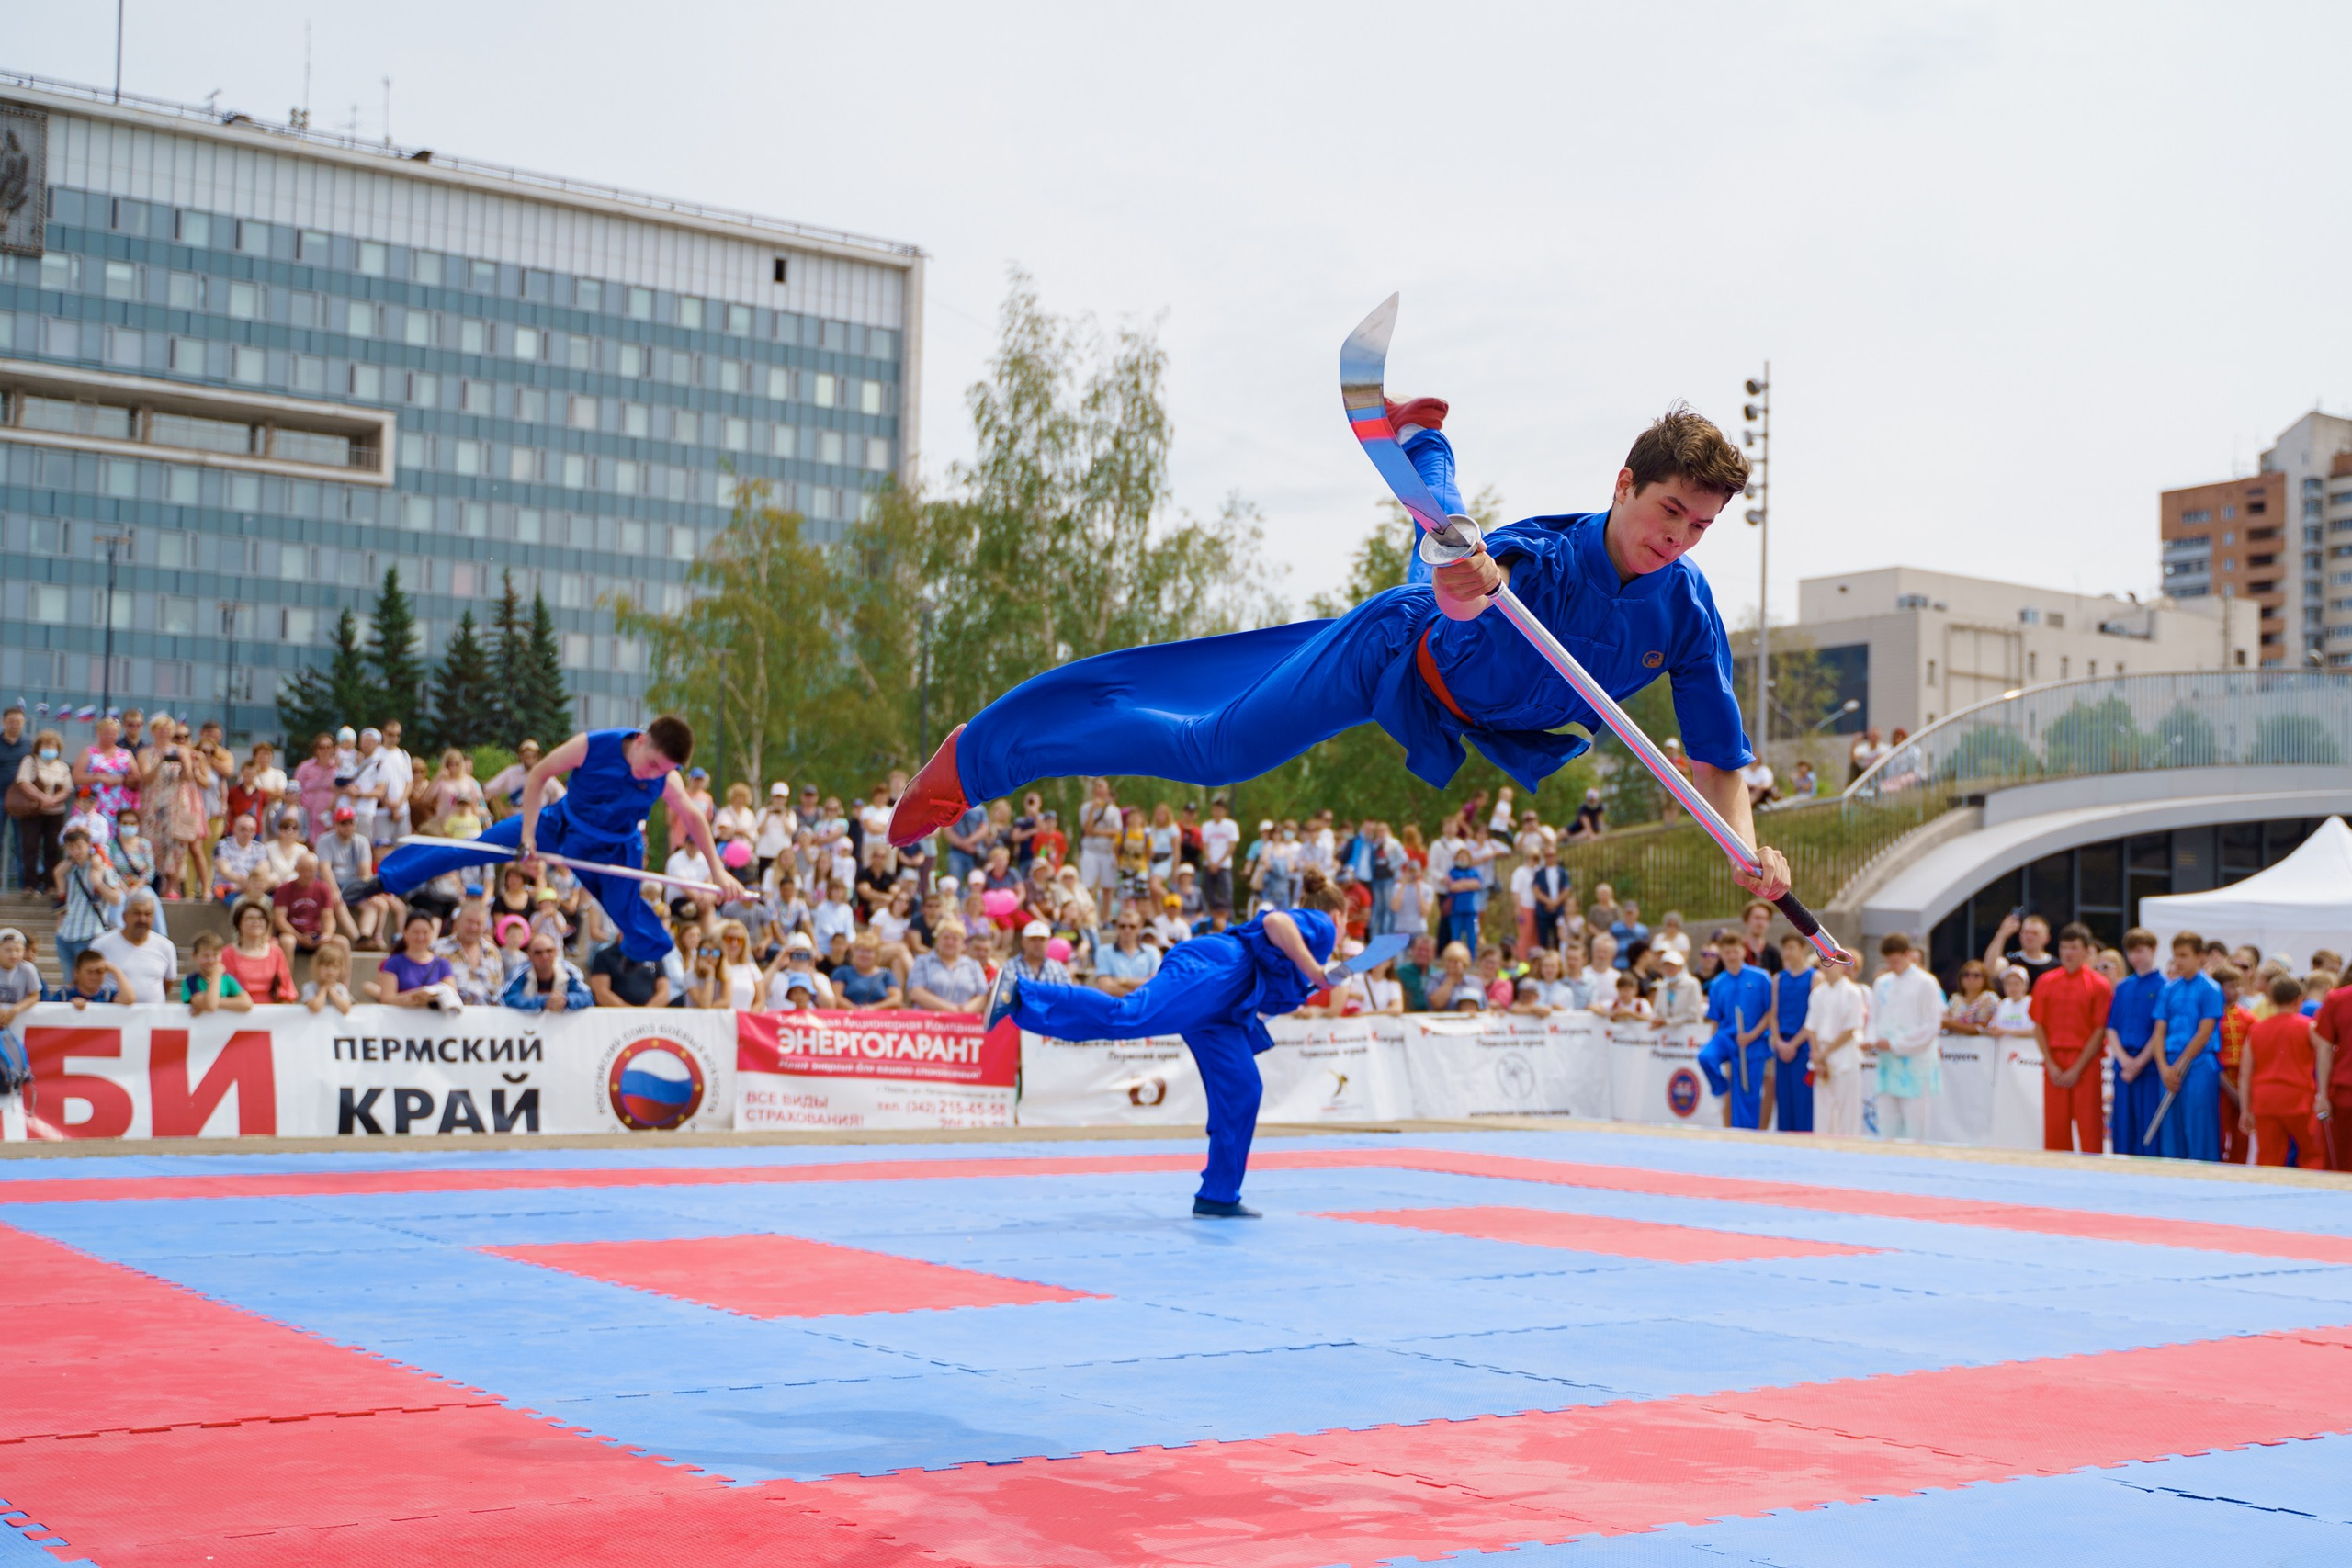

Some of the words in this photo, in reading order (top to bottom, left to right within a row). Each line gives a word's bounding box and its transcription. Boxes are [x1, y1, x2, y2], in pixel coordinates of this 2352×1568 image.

[334, 1031, 543, 1063] ПЕРМСКИЙ
[776, 1027, 984, 1064] ЭНЕРГОГАРАНТ
[0, 1026, 276, 1138] БИ
[337, 1072, 540, 1135] КРАЙ
[746, 1091, 776, 1105] ВСЕ
[783, 1093, 829, 1109] ВИДЫ
[745, 1109, 864, 1127] СТРАХОВАНИЯ!
